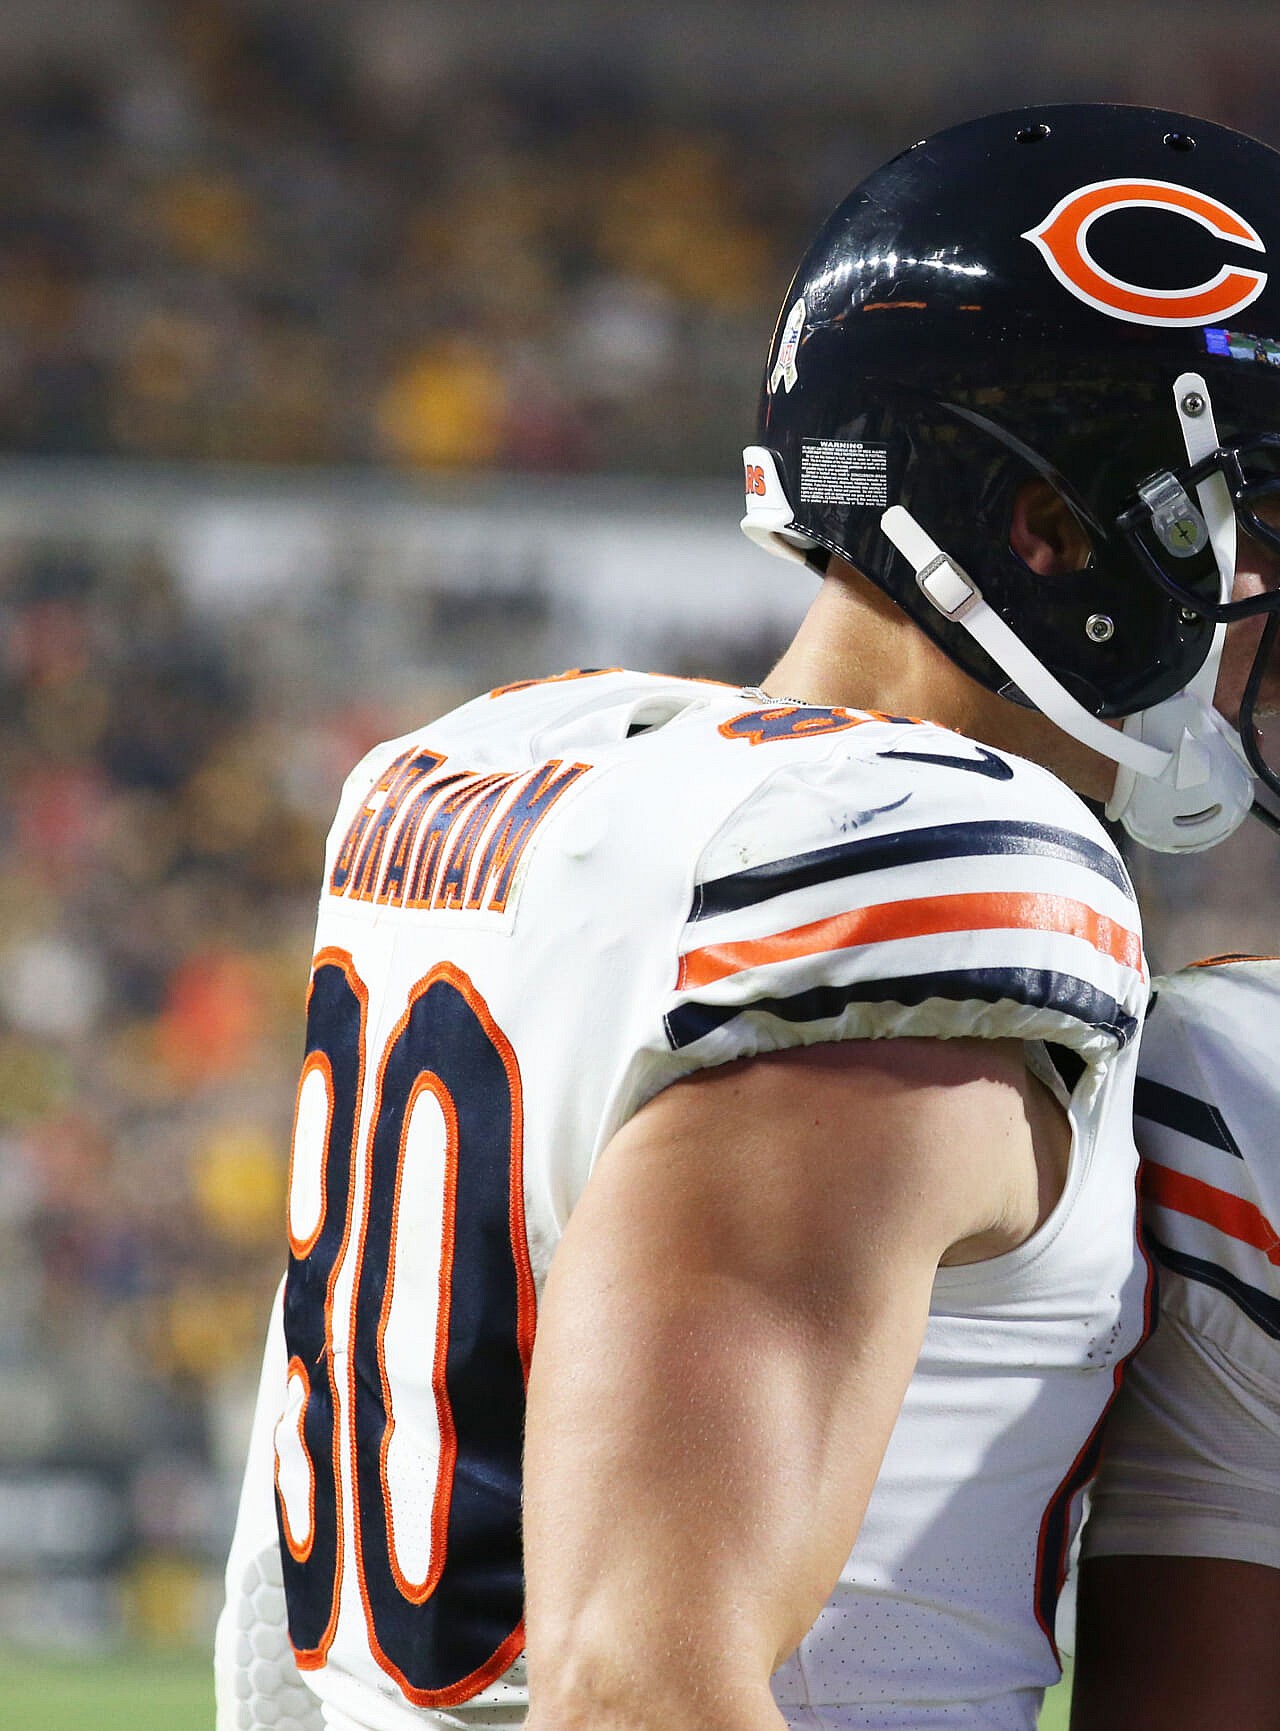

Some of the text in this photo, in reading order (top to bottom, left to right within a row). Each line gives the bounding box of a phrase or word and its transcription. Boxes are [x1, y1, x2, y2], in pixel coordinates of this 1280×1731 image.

[1020, 177, 1268, 328] C
[820, 441, 864, 449] WARNING
[329, 745, 595, 913] GRAHAM
[274, 945, 538, 1709] 80
